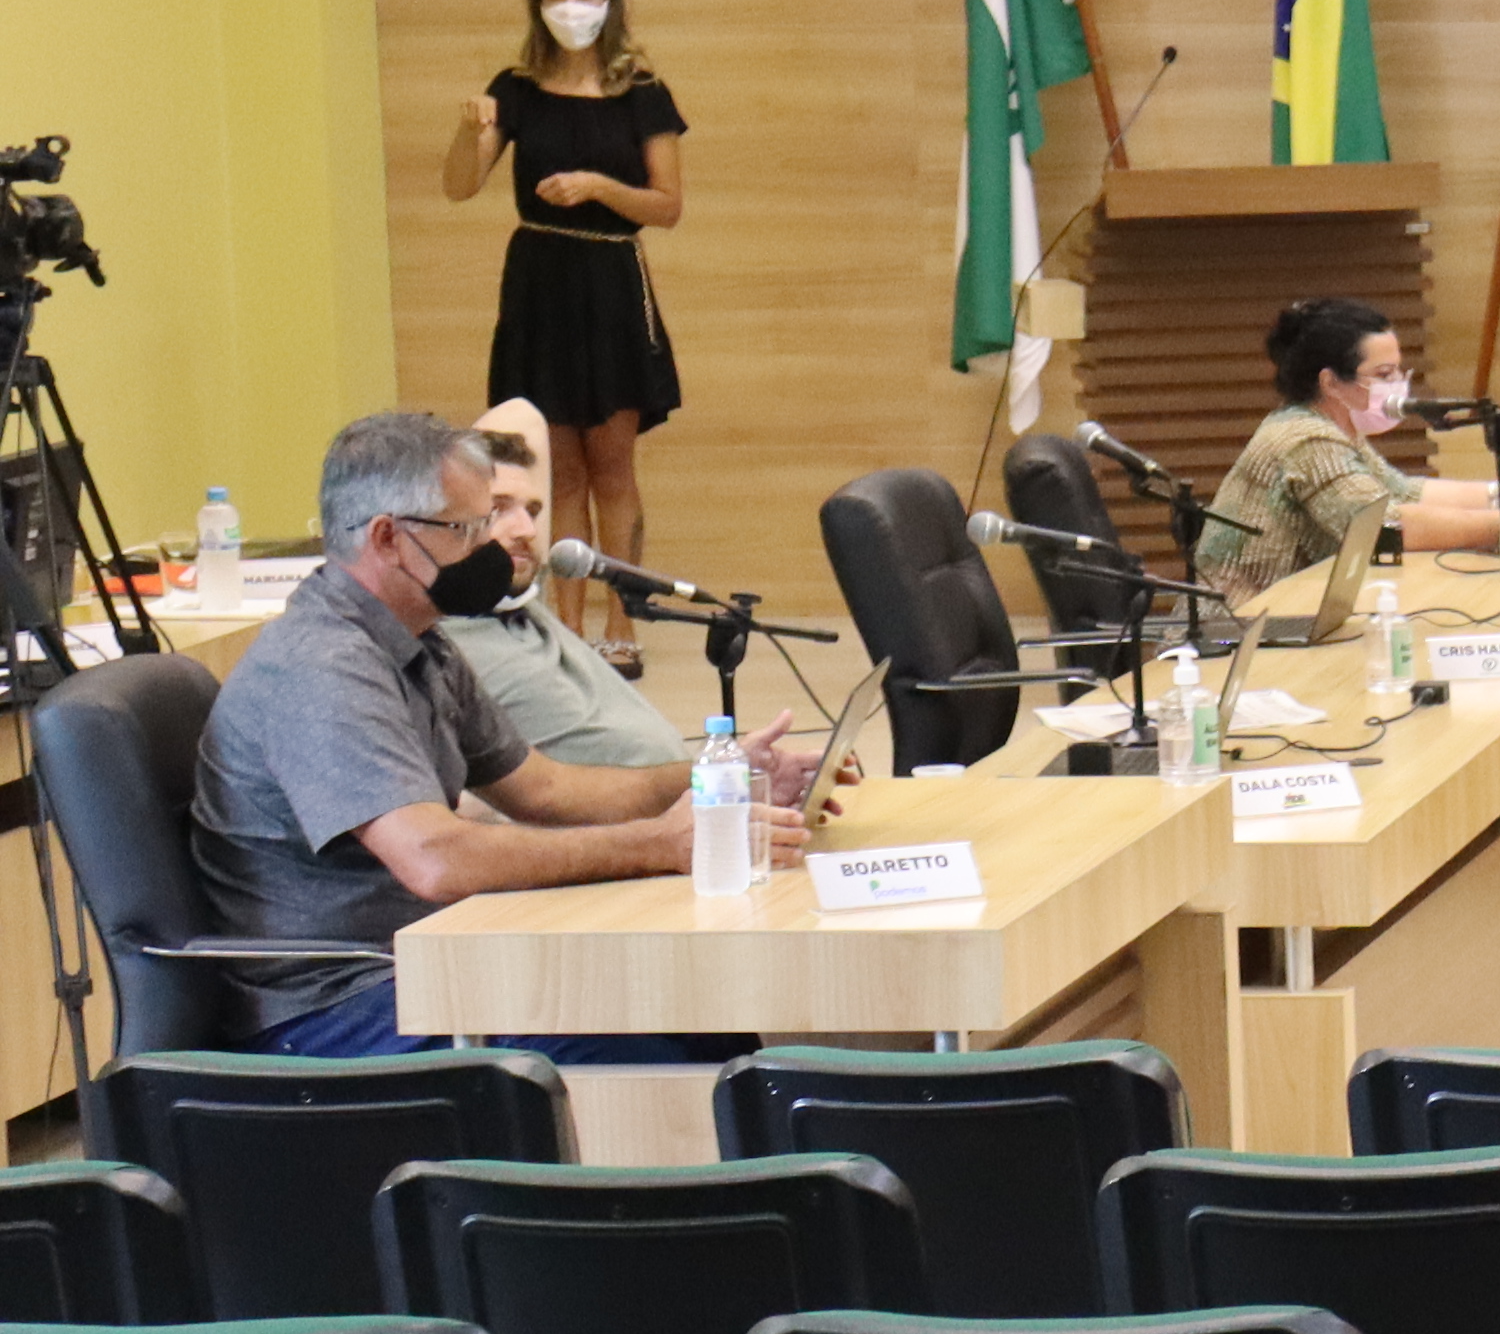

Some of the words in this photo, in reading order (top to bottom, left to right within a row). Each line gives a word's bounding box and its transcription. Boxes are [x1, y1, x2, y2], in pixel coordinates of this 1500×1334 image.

[1439, 644, 1475, 658] CRIS
[1238, 776, 1284, 794] DALA
[1285, 773, 1340, 789] COSTA
[839, 854, 949, 878] BOARETTO
